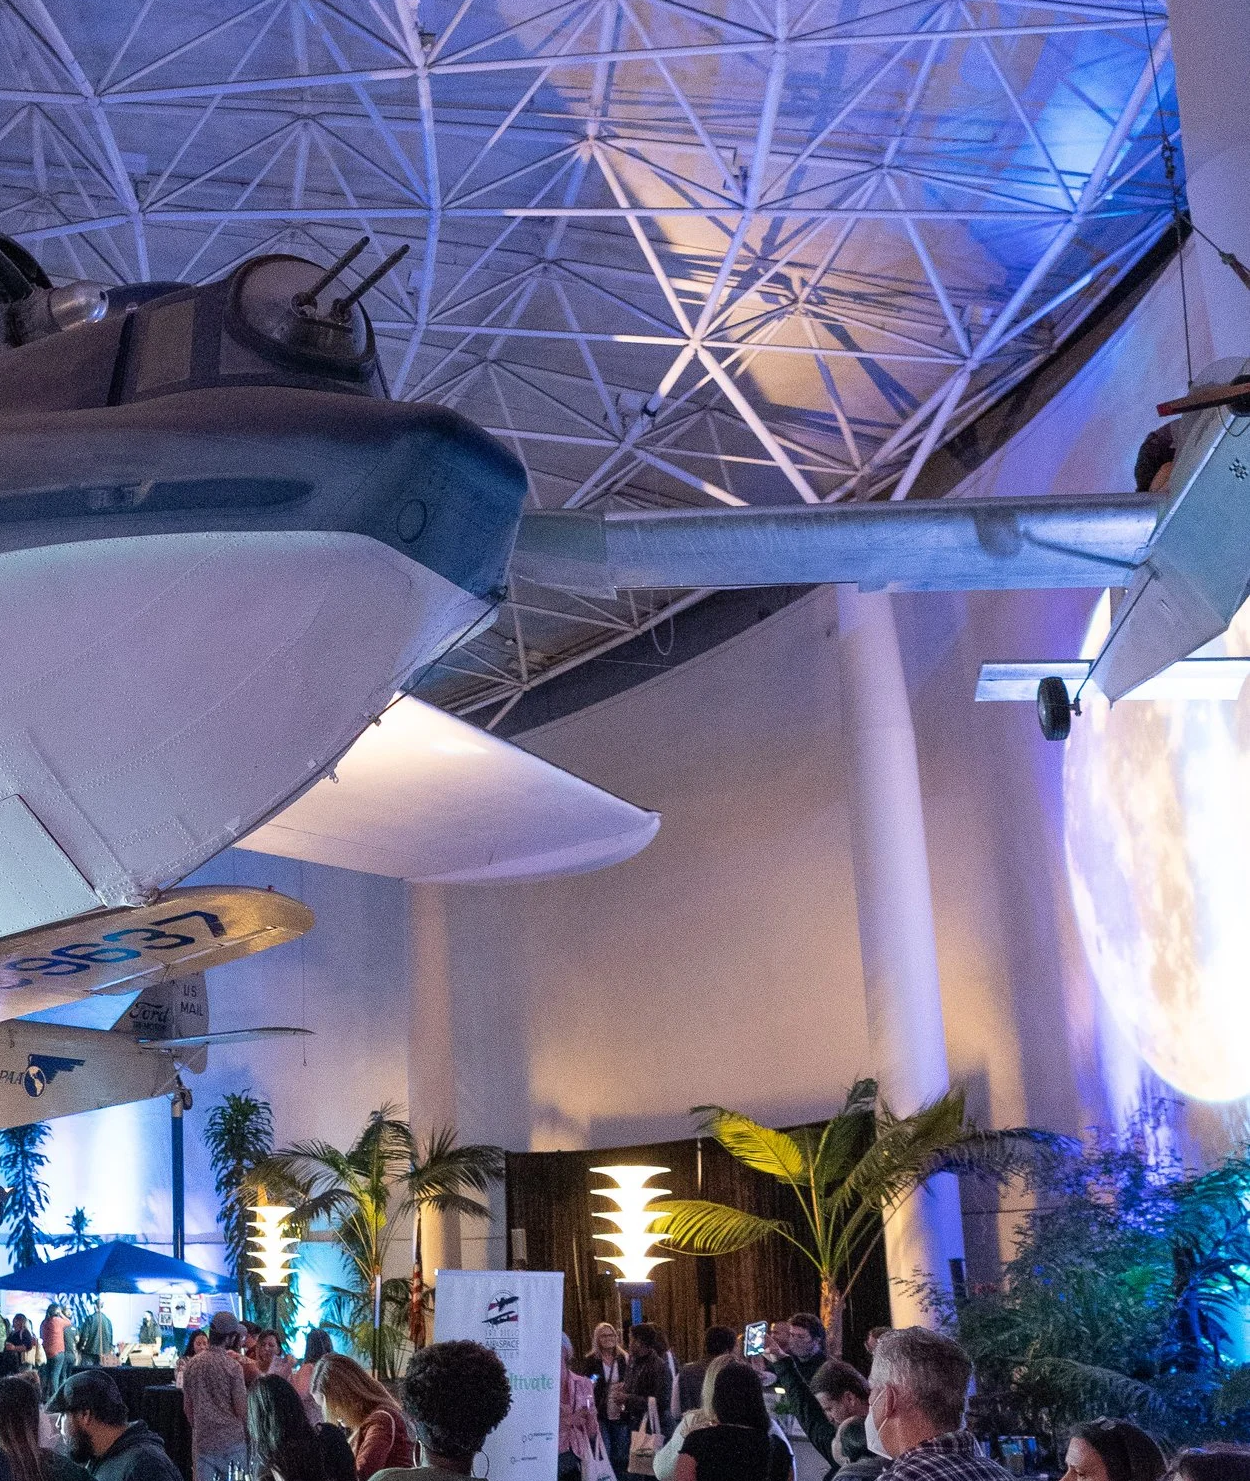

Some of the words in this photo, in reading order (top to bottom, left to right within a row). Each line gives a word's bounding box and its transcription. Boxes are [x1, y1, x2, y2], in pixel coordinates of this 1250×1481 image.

[183, 984, 197, 998] US
[129, 1001, 170, 1023] Ford
[180, 1001, 204, 1017] MAIL
